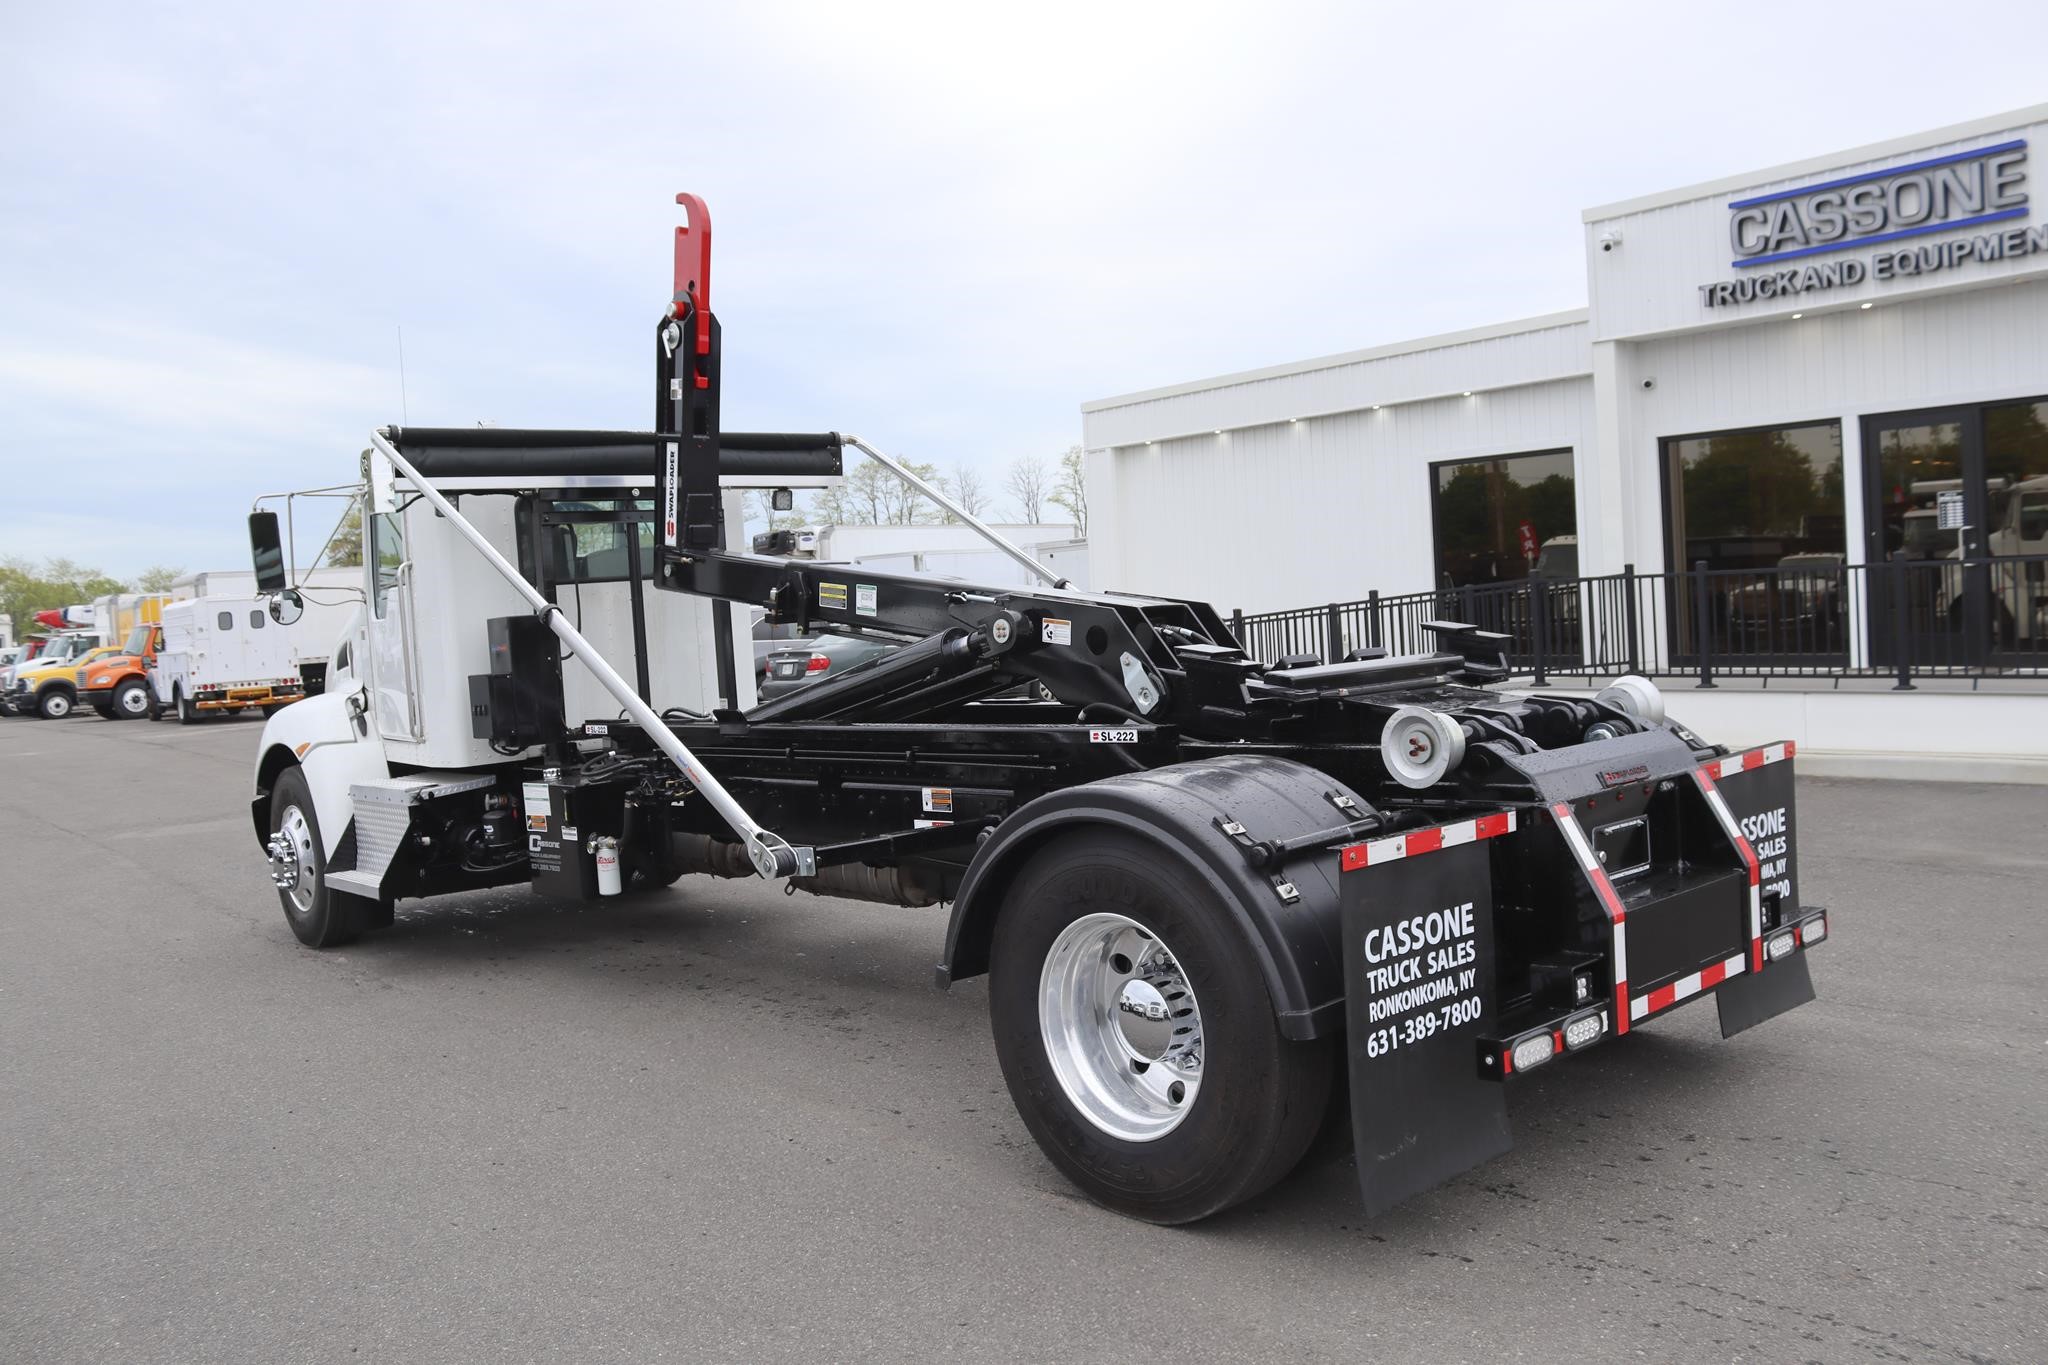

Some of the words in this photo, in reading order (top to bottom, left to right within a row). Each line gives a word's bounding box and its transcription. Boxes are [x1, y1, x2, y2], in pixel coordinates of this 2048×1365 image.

[1730, 151, 2028, 257] CASSONE
[1699, 270, 1801, 308] TRUCK
[1801, 259, 1865, 293] AND
[1872, 224, 2048, 281] EQUIPMEN
[668, 451, 676, 519] SWAPLOADER
[1100, 731, 1135, 742] SL-222
[1740, 807, 1787, 842] SSONE
[1758, 836, 1787, 861] SALES
[1364, 902, 1475, 964] CASSONE
[1366, 956, 1422, 995] TRUCK
[1427, 940, 1476, 975] SALES
[1369, 975, 1458, 1023] RONKONKOMA,
[1459, 968, 1477, 991] NY
[1367, 995, 1482, 1059] 631-389-7800
